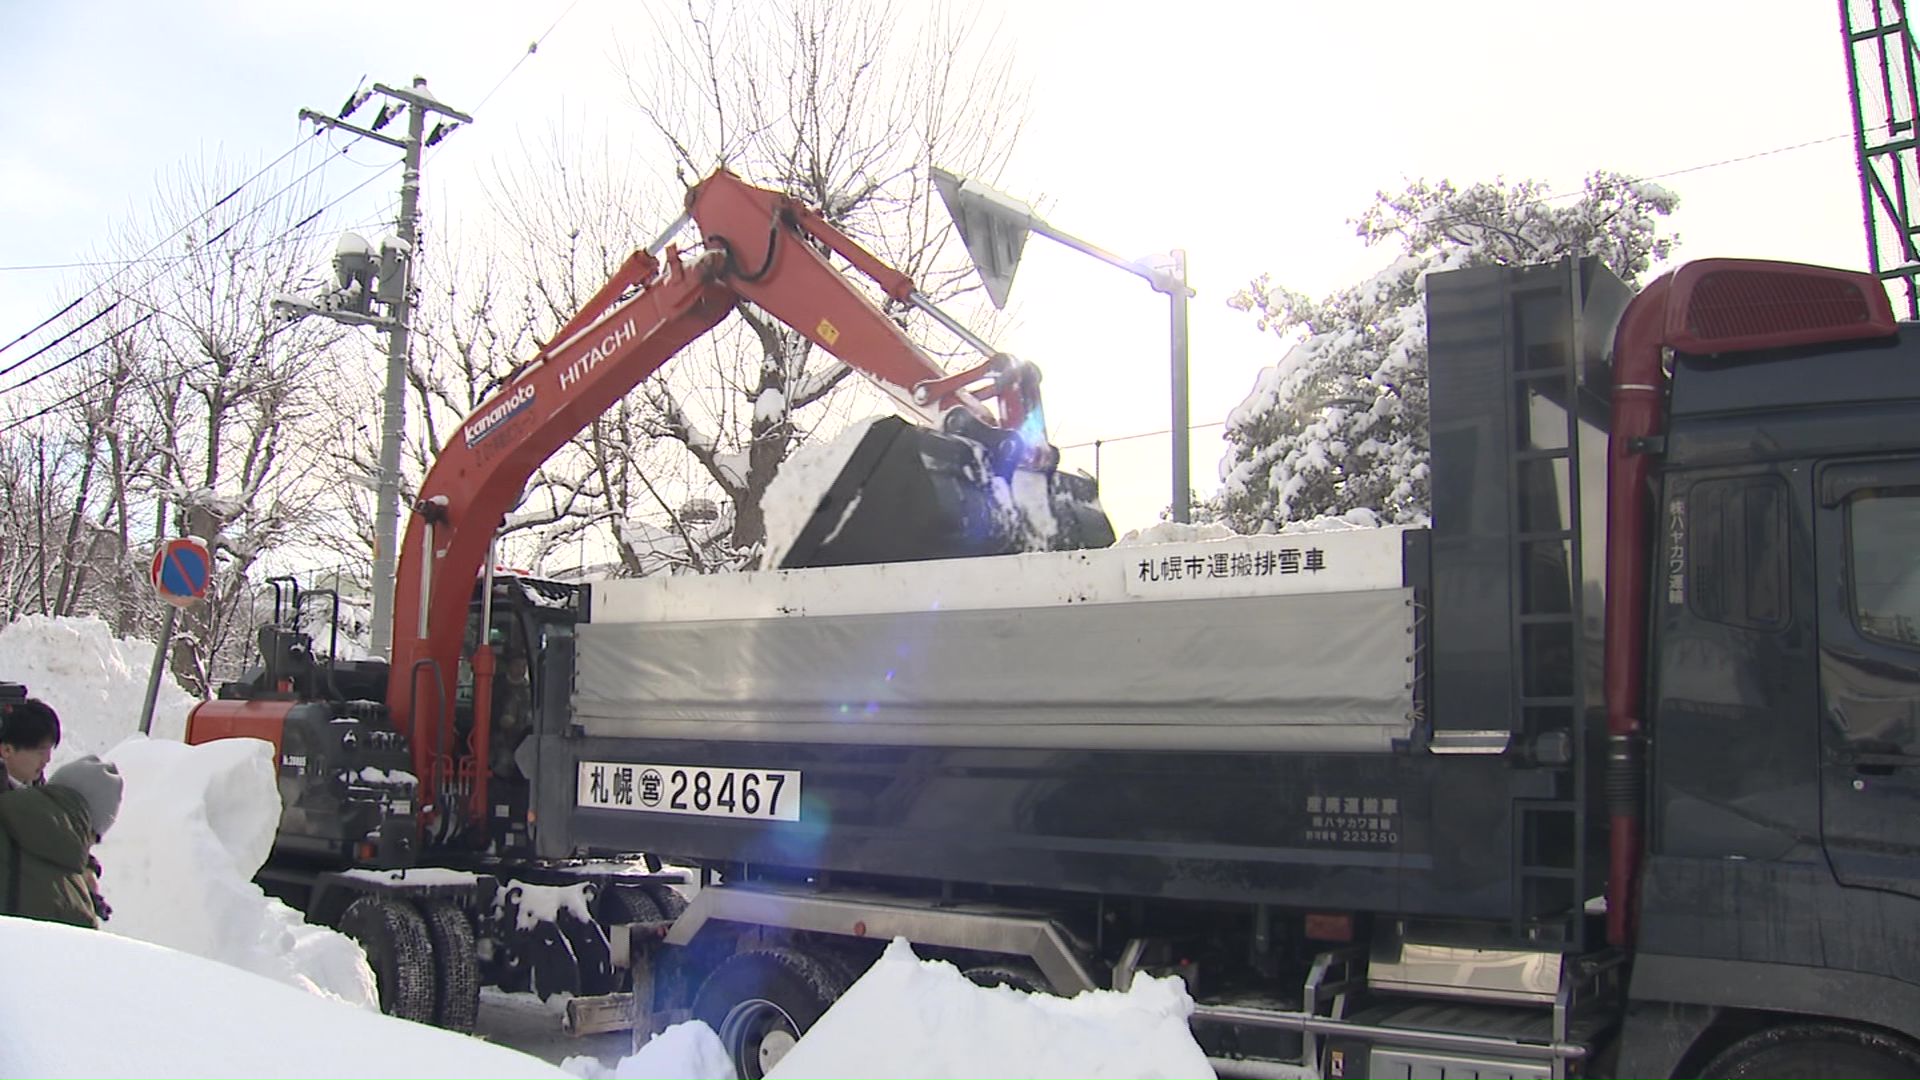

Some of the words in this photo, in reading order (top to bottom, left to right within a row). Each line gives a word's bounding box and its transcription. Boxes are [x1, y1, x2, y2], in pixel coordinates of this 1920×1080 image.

[559, 318, 638, 391] HITACHI
[463, 383, 536, 444] kanamoto
[1138, 547, 1327, 583] 札幌市運搬排雪車
[1343, 831, 1398, 843] 223250
